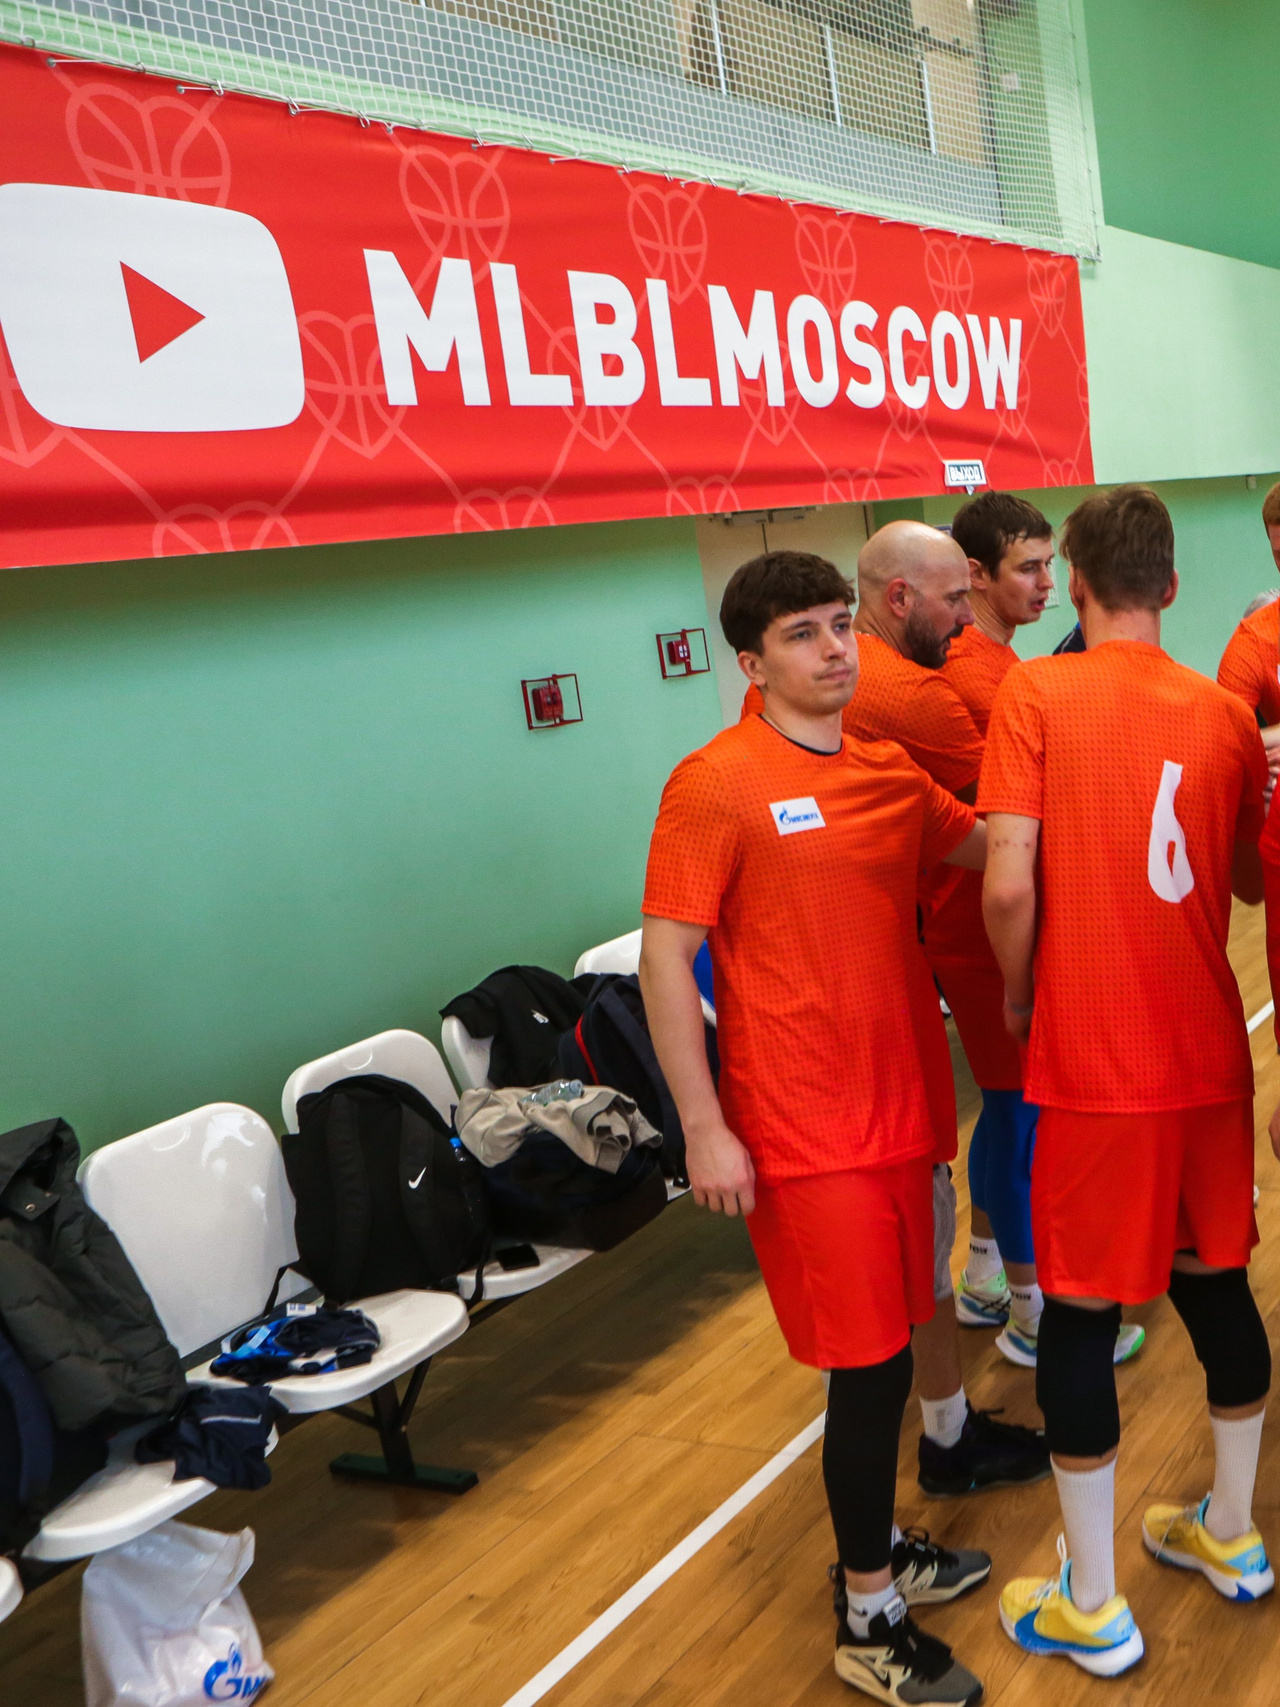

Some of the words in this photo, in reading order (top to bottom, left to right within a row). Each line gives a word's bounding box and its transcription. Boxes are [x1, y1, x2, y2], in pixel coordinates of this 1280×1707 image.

[363, 248, 1022, 410] MLBLMOSCOW
[949, 465, 982, 481] ВЫХОД
[1148, 760, 1194, 903] 6
